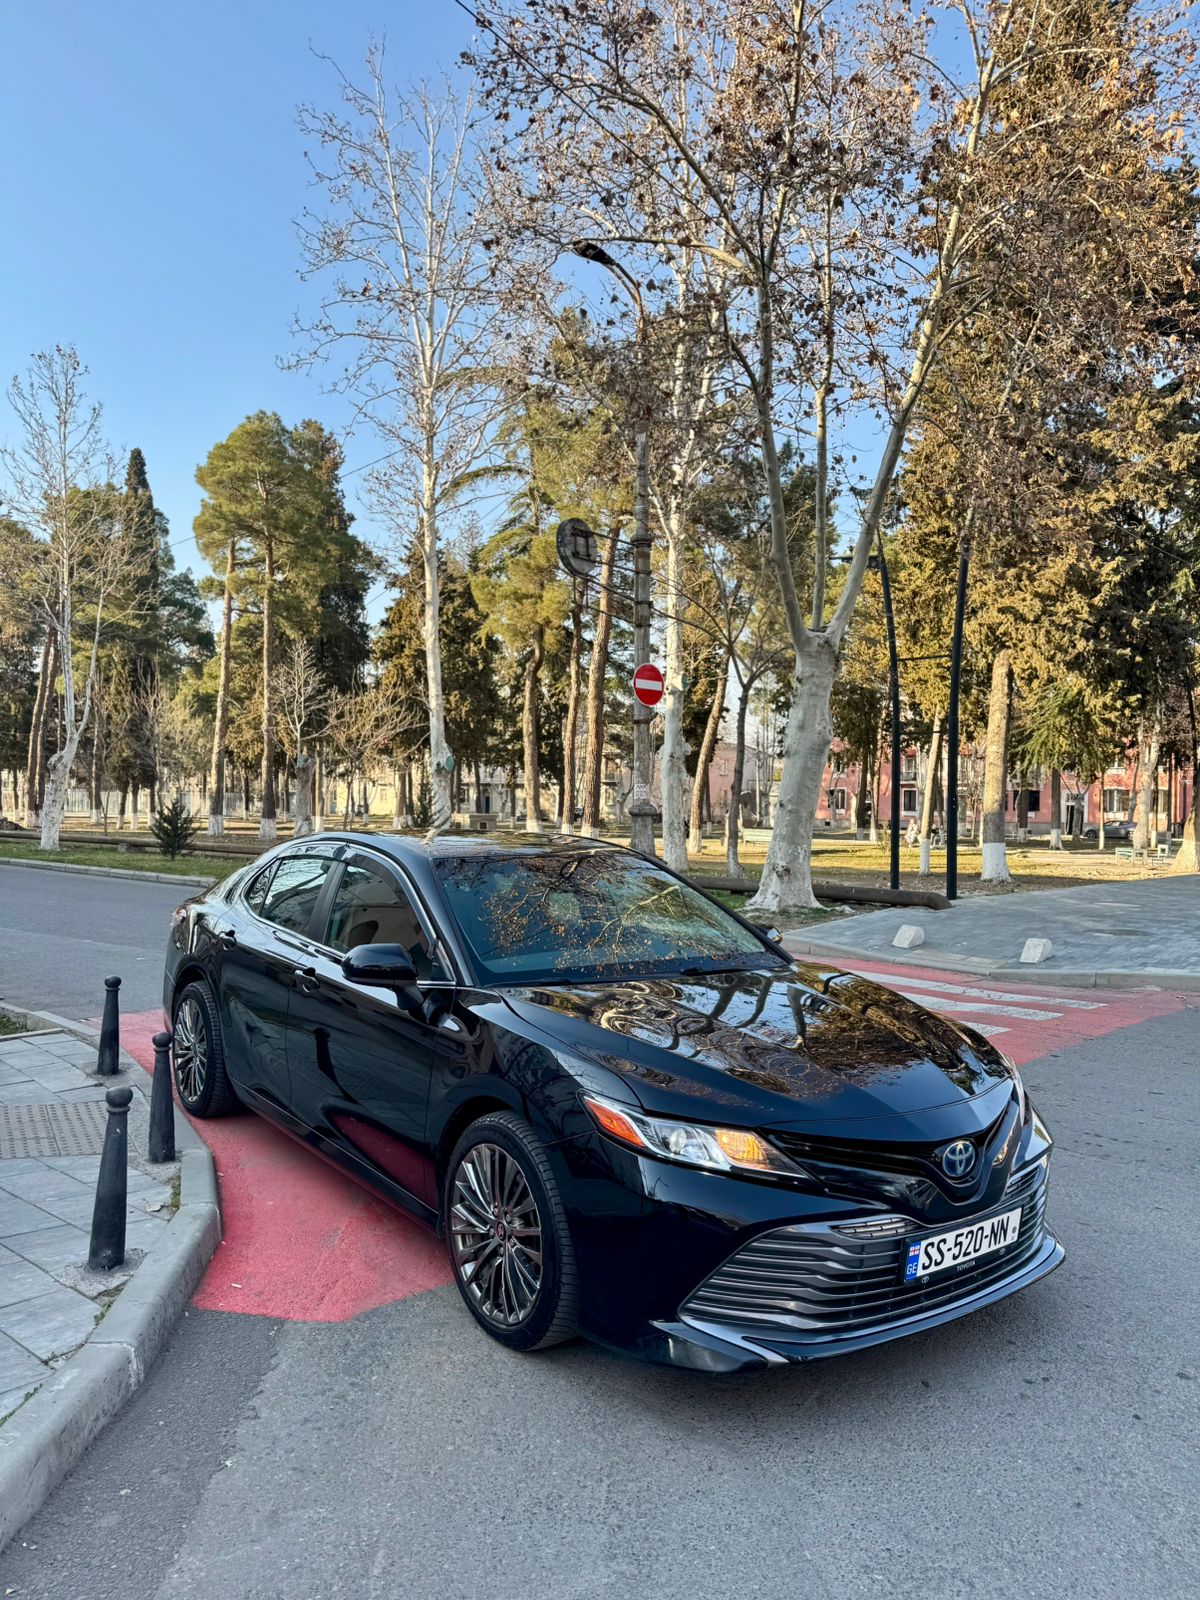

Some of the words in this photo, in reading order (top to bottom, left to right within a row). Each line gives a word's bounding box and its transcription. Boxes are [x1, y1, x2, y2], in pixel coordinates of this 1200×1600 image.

[921, 1216, 1010, 1270] SS-520-NN
[906, 1262, 917, 1275] GE
[957, 1260, 976, 1271] TOYOTA
